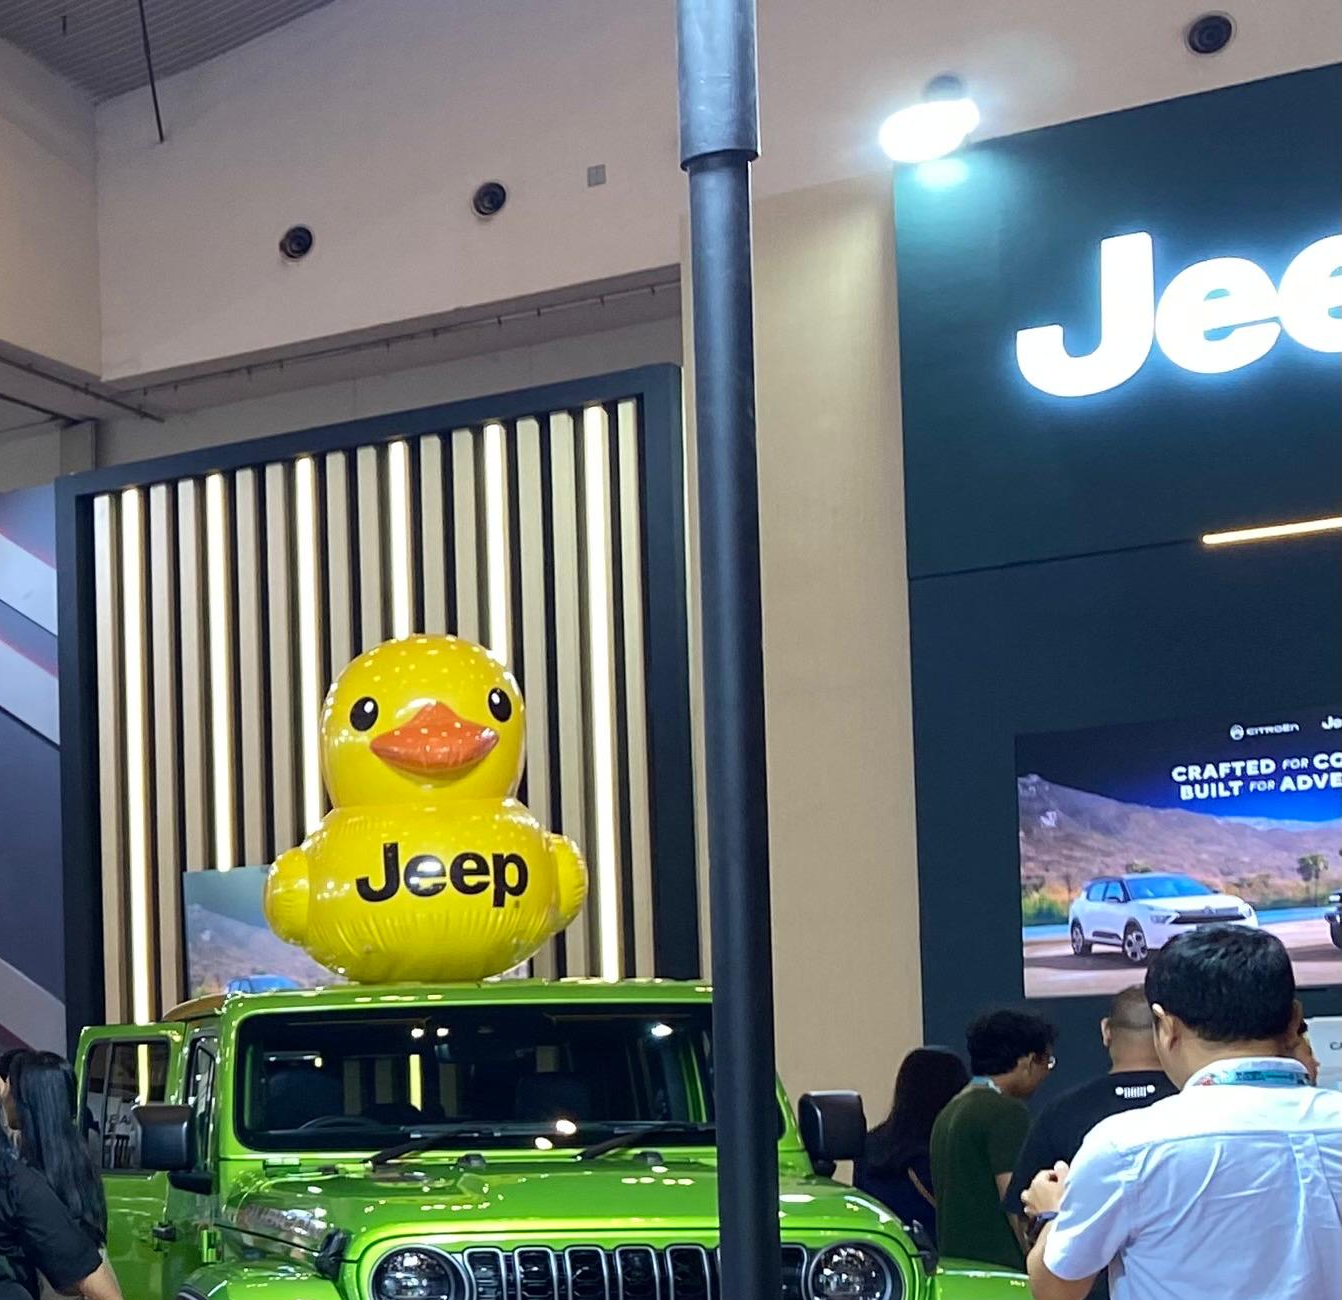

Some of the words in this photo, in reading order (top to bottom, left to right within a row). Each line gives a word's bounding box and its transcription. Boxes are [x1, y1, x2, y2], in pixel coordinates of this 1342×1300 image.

[1171, 758, 1277, 782] CRAFTED
[1281, 757, 1310, 770] FOR
[1179, 780, 1244, 800] BUILT
[1249, 780, 1276, 792] FOR
[355, 842, 528, 907] Jeep
